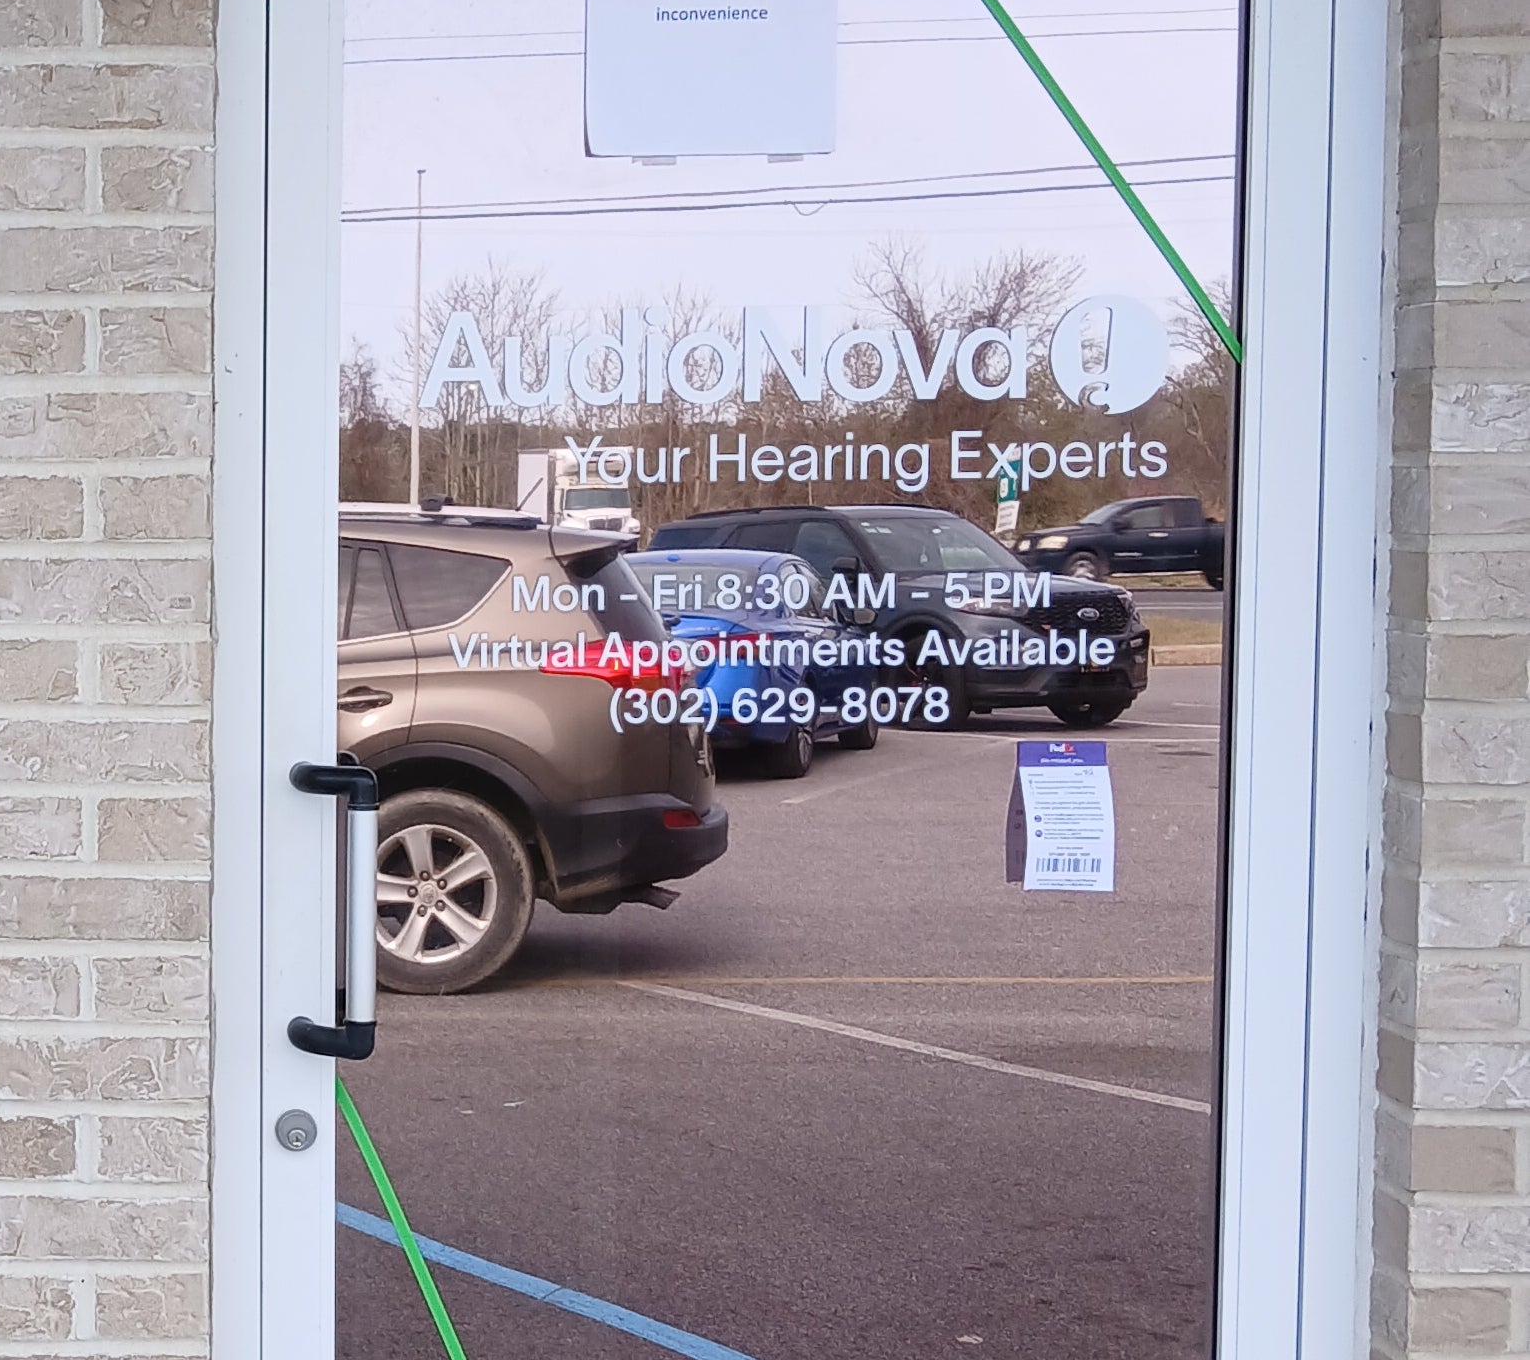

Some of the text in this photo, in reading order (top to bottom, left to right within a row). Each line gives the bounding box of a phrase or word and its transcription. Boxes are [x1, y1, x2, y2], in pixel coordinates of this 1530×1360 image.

[657, 7, 769, 22] inconvenience
[418, 304, 1028, 408] AudioNova
[565, 430, 1168, 492] Your Hearing Experts
[512, 576, 606, 612] Mon
[653, 574, 702, 611] Fri
[716, 573, 810, 610] 8:30
[822, 573, 896, 609] AM
[944, 572, 970, 609] 5
[984, 571, 1052, 608] PM
[448, 629, 1116, 677] Virtual Appointments Available
[609, 685, 950, 733] (302) 629-8078
